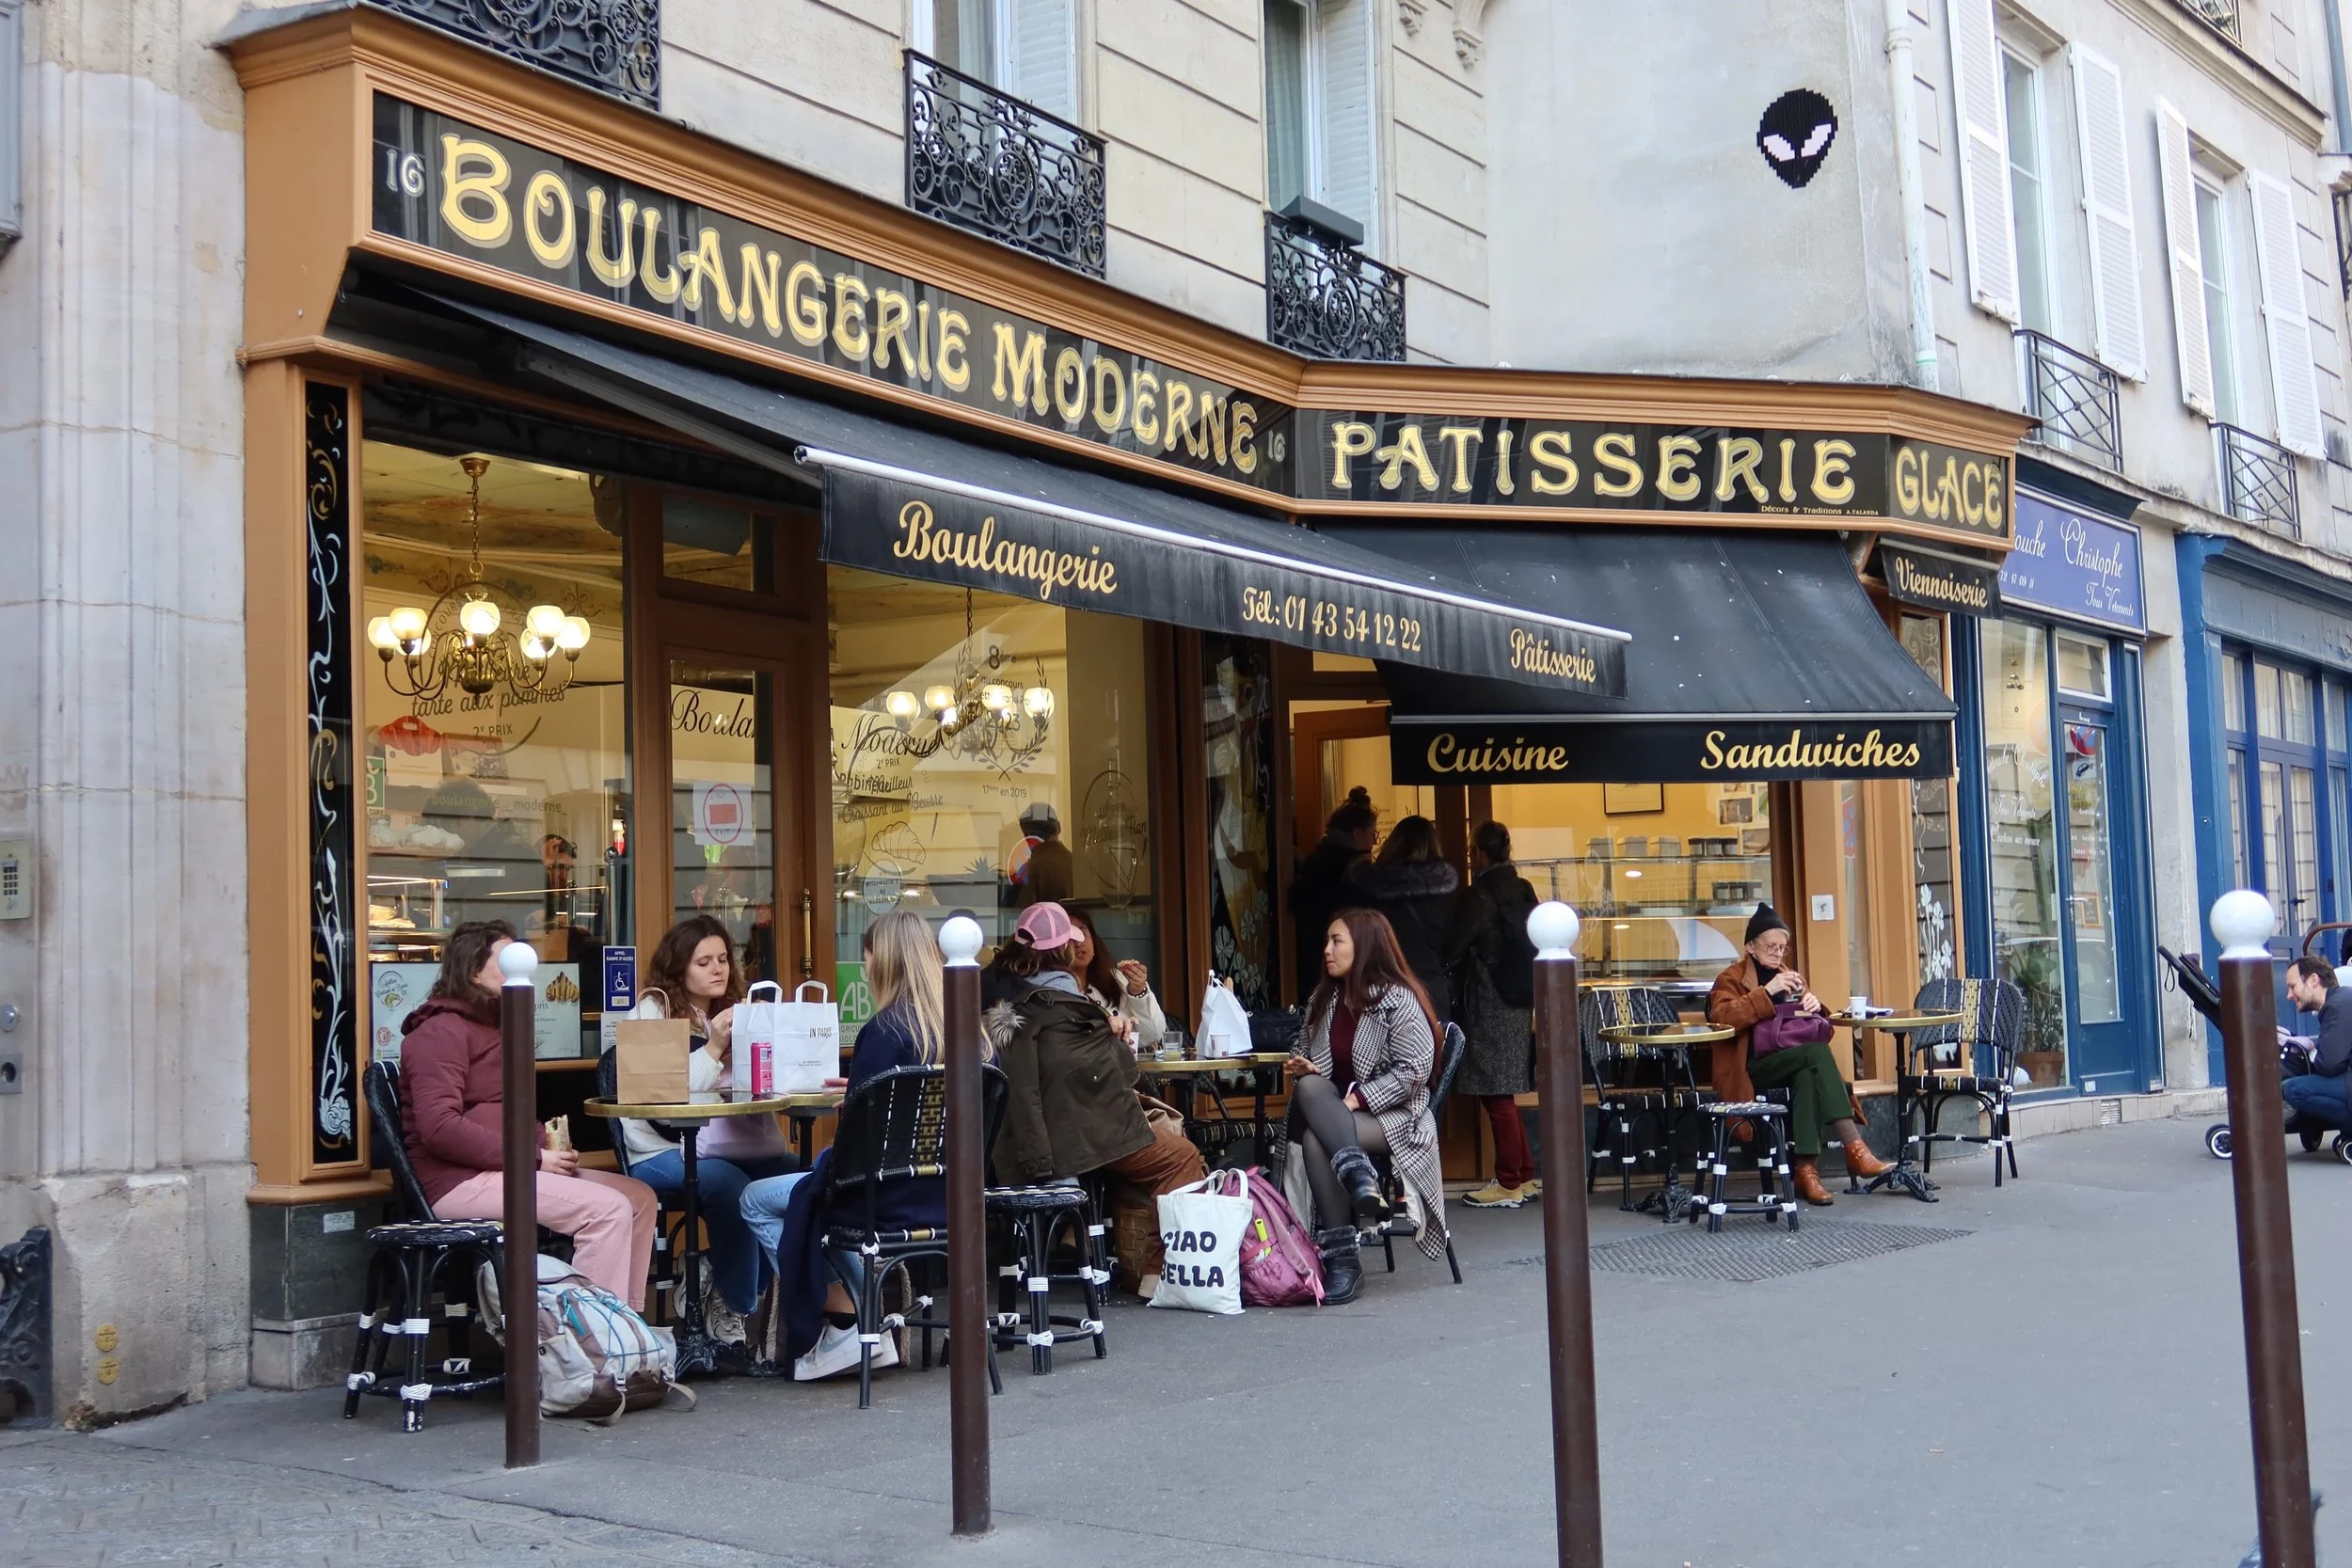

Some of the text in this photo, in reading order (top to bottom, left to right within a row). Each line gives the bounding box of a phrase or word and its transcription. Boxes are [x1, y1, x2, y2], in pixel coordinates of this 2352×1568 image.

[387, 133, 1286, 474] 16 BOULANGERIE MODERNE 16
[1331, 421, 1857, 504] PATISSERIE
[1761, 505, 1789, 514] Décors
[1803, 506, 1842, 515] Traditions
[1895, 446, 2003, 529] GLACE
[893, 499, 1118, 600] Boulangerie
[2060, 518, 2123, 588] Christophe
[1895, 556, 1988, 609] Viennoiserie
[1284, 594, 1306, 632] 01
[1311, 600, 1338, 637] 43
[1343, 607, 1370, 643] 54
[1374, 612, 1396, 647] 12
[1399, 619, 1422, 653] 22
[1510, 626, 1597, 684] Pâtisserie
[411, 692, 453, 719] tarte
[992, 677, 1024, 689] concours
[488, 723, 514, 736] PRIX
[671, 689, 755, 738] Boula
[841, 713, 938, 756] Moderne
[885, 757, 901, 768] PRIX
[1426, 728, 1921, 773] Cuisine Sandwiches
[1000, 788, 1009, 798] en
[1009, 787, 1027, 799] 2019
[1163, 1229, 1217, 1253] CIAO
